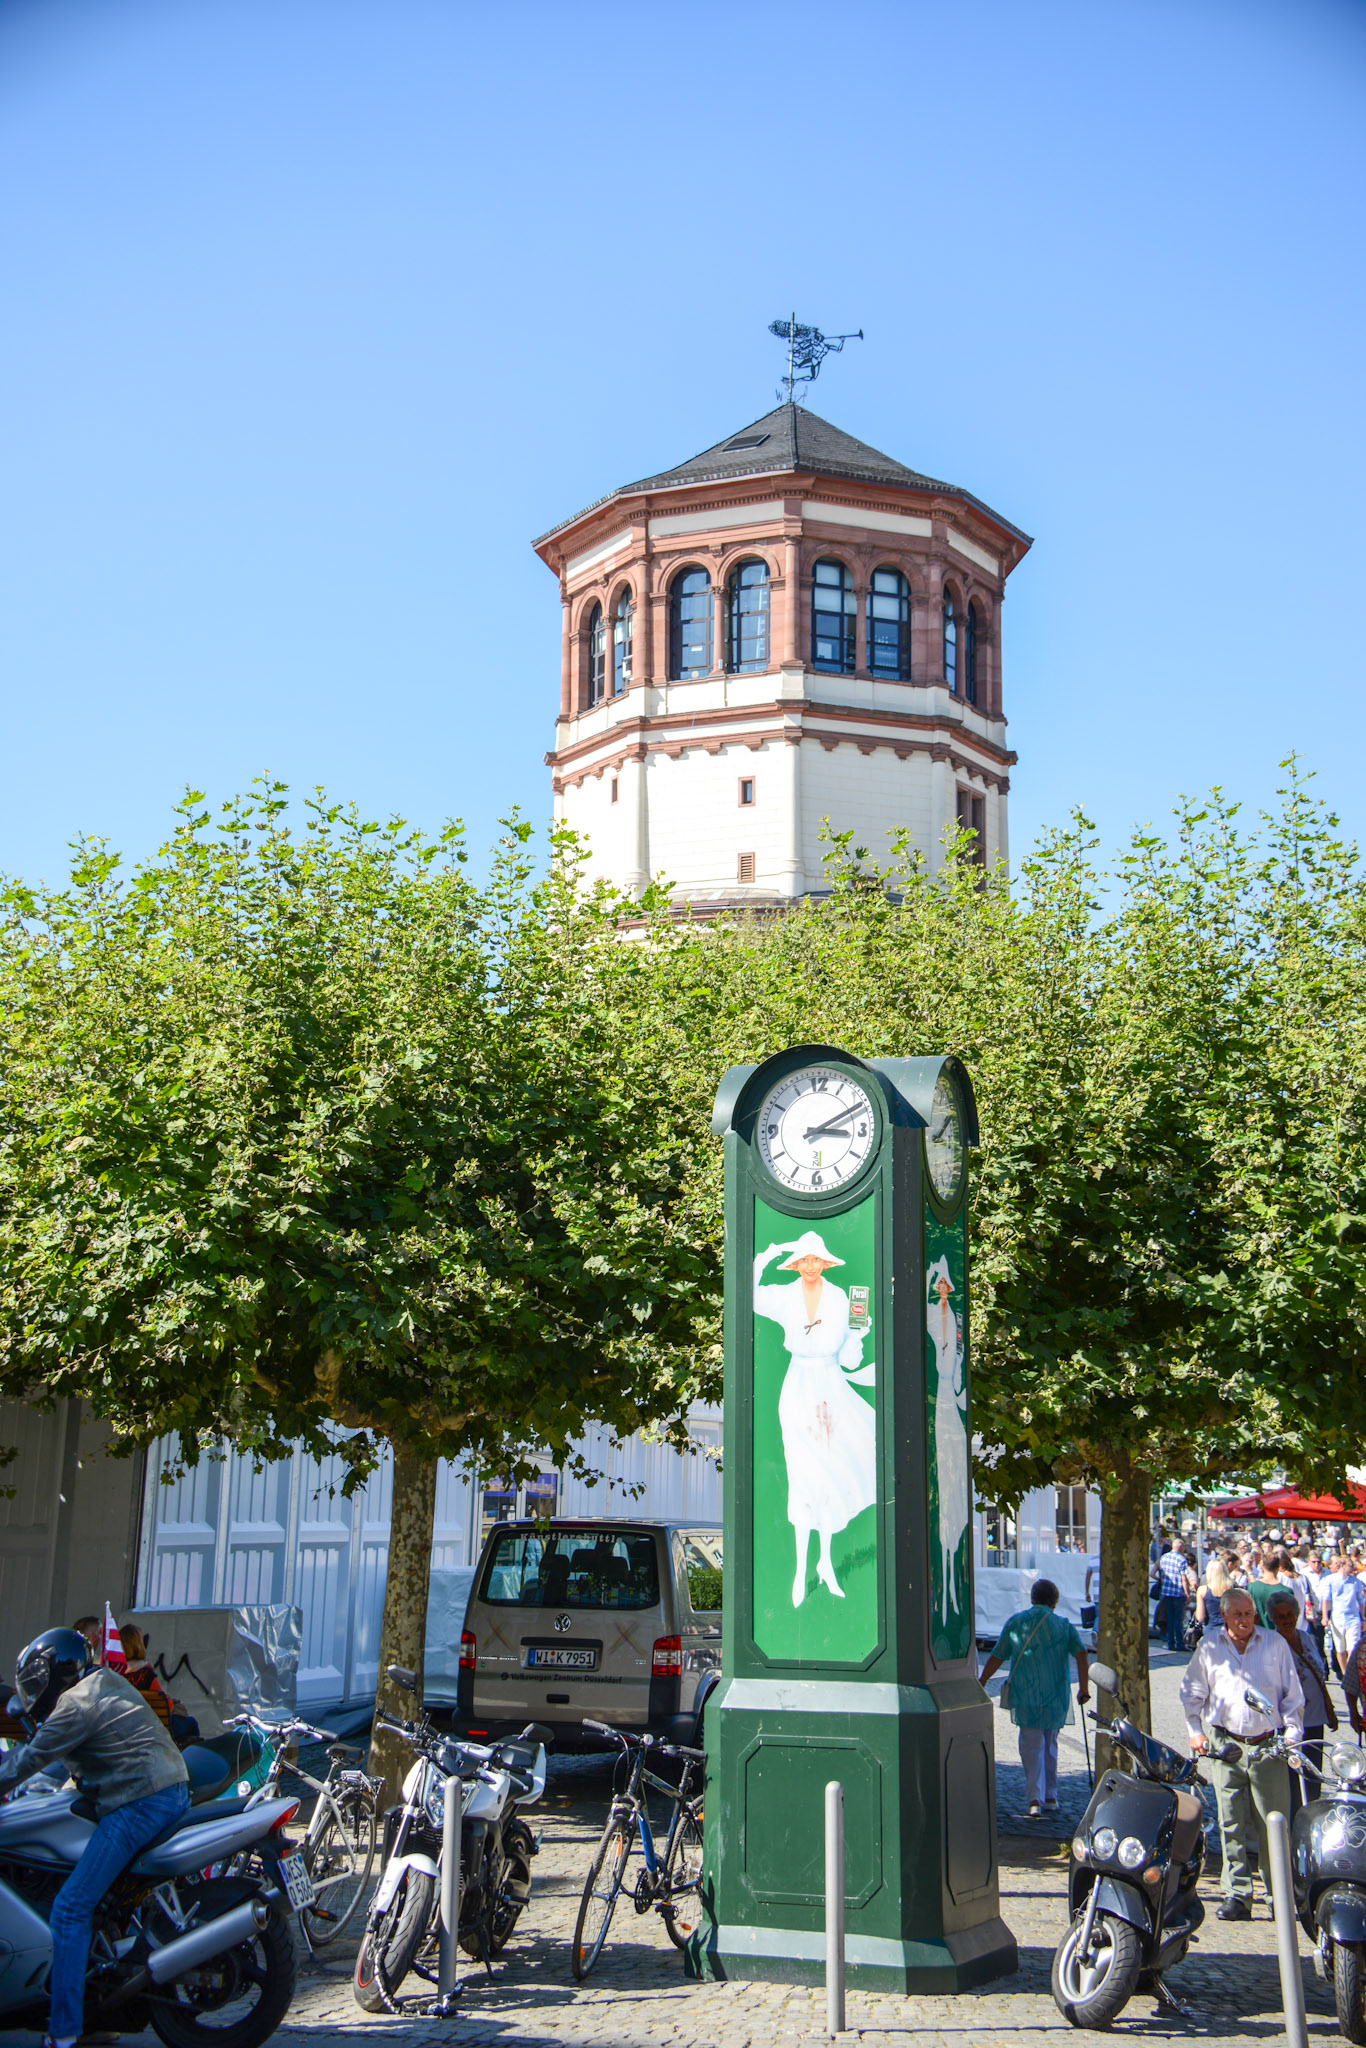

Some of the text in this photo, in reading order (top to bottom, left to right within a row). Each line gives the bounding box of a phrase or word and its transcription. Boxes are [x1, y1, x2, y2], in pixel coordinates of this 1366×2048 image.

[808, 1077, 828, 1092] 12
[767, 1124, 779, 1140] 9
[857, 1122, 868, 1138] 3
[811, 1170, 823, 1185] 6
[536, 1651, 592, 1665] WI K 7951
[511, 1672, 622, 1684] Volkswagen Zentrum Düsseldorf
